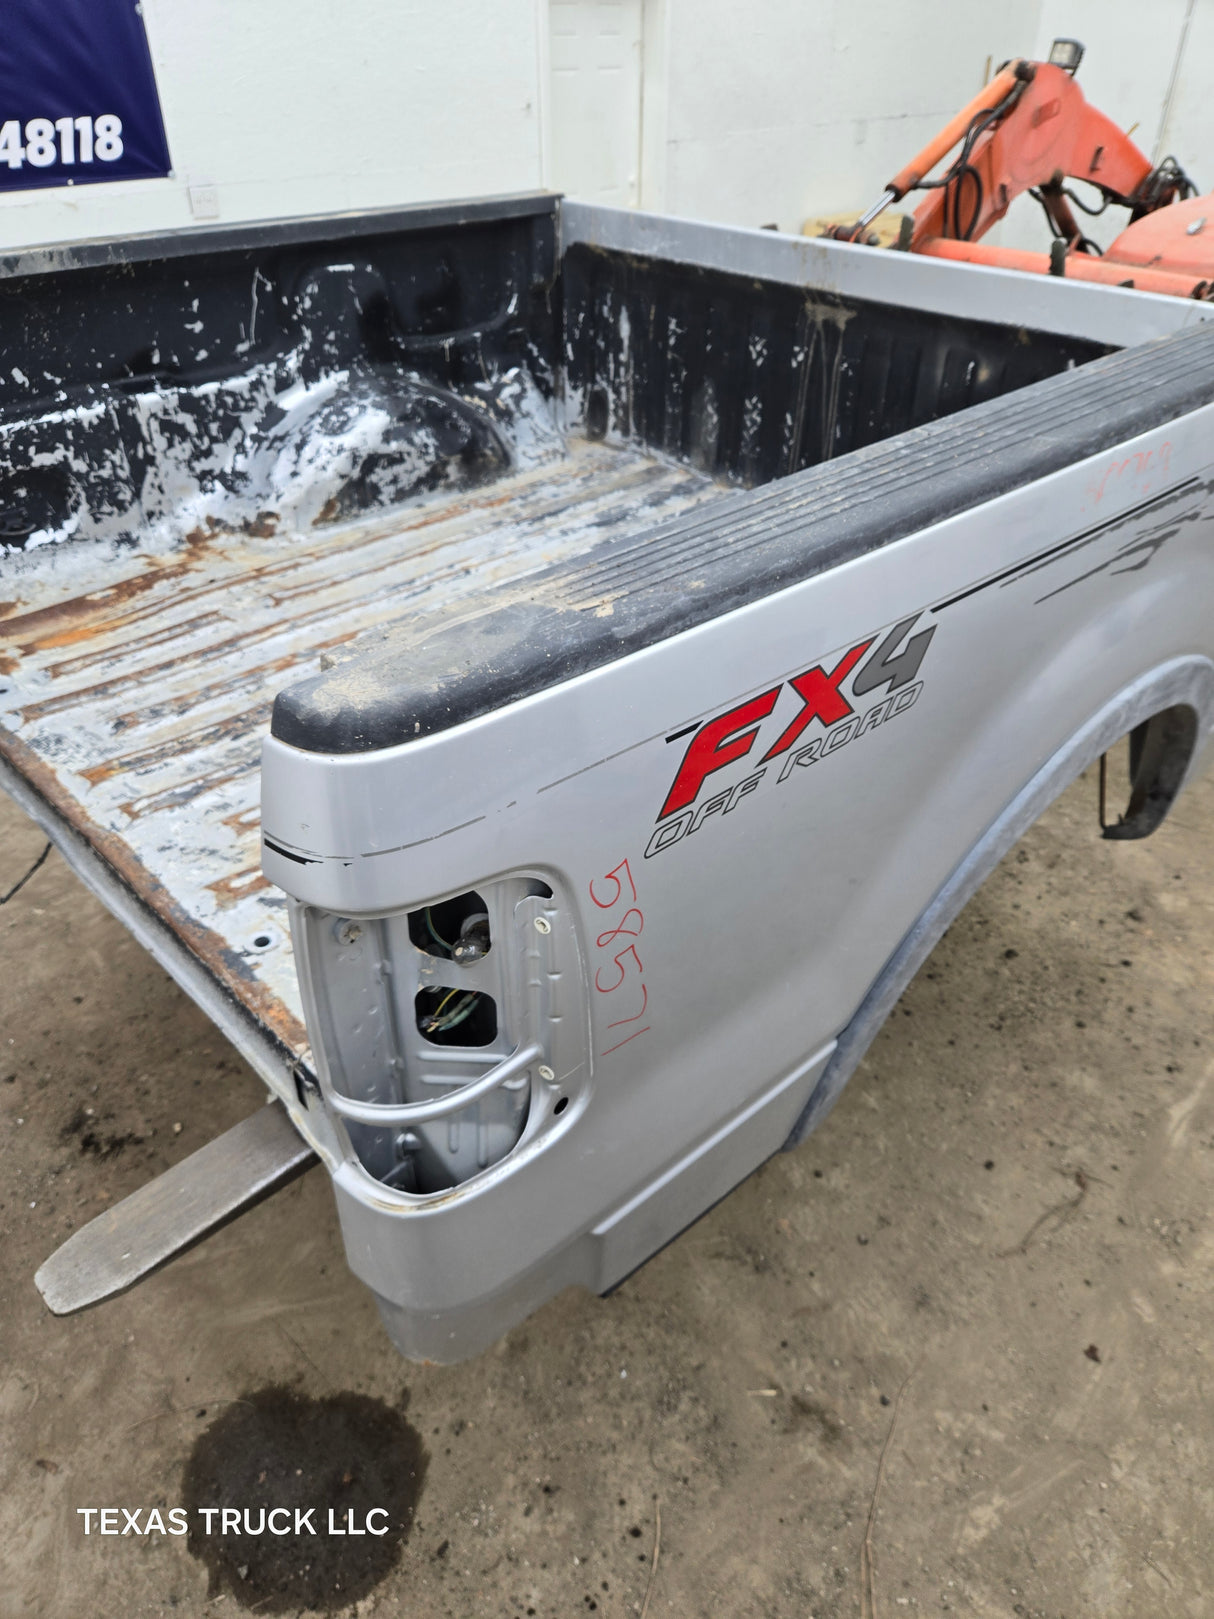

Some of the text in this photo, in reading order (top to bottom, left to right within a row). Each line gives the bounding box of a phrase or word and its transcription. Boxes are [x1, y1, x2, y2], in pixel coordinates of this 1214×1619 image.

[0, 114, 124, 169] 48118
[644, 680, 925, 859] OFF ROAD
[655, 610, 938, 824] FX4
